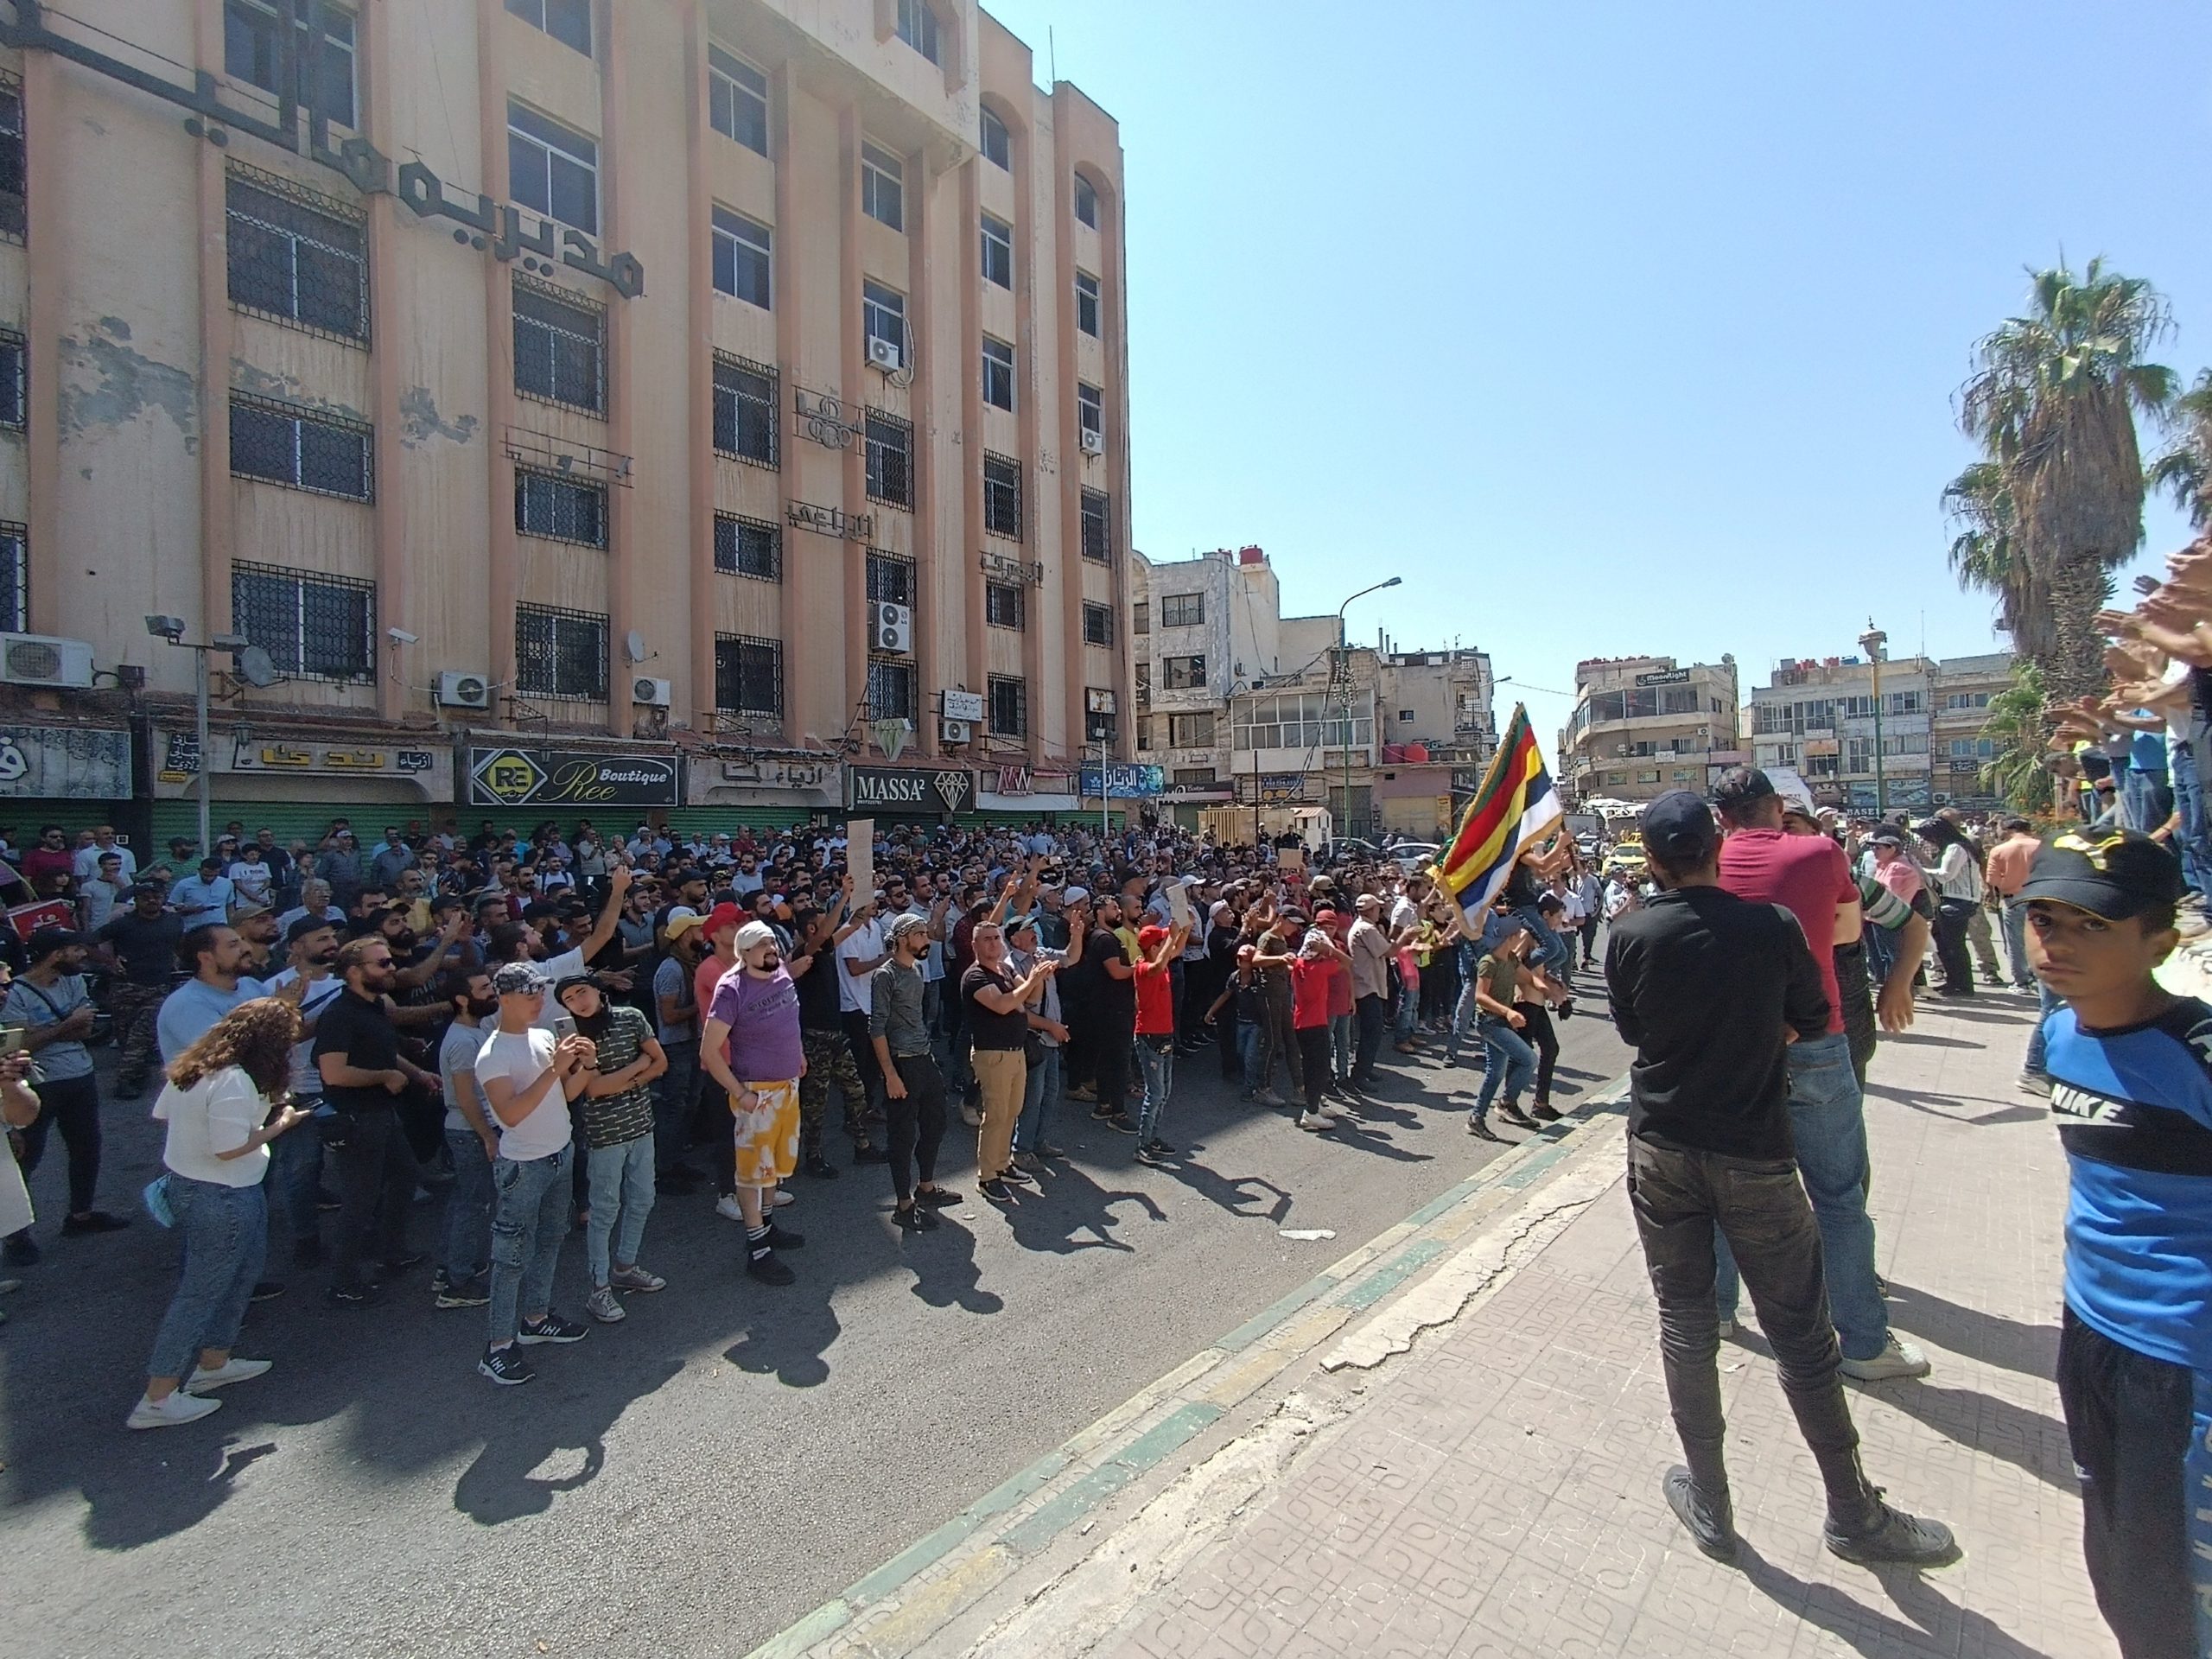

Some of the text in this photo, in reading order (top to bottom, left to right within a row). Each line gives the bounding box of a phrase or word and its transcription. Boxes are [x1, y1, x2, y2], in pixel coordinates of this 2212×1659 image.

[536, 760, 618, 802] Ree
[600, 768, 668, 785] Boutique
[2051, 1083, 2124, 1122] NIKE
